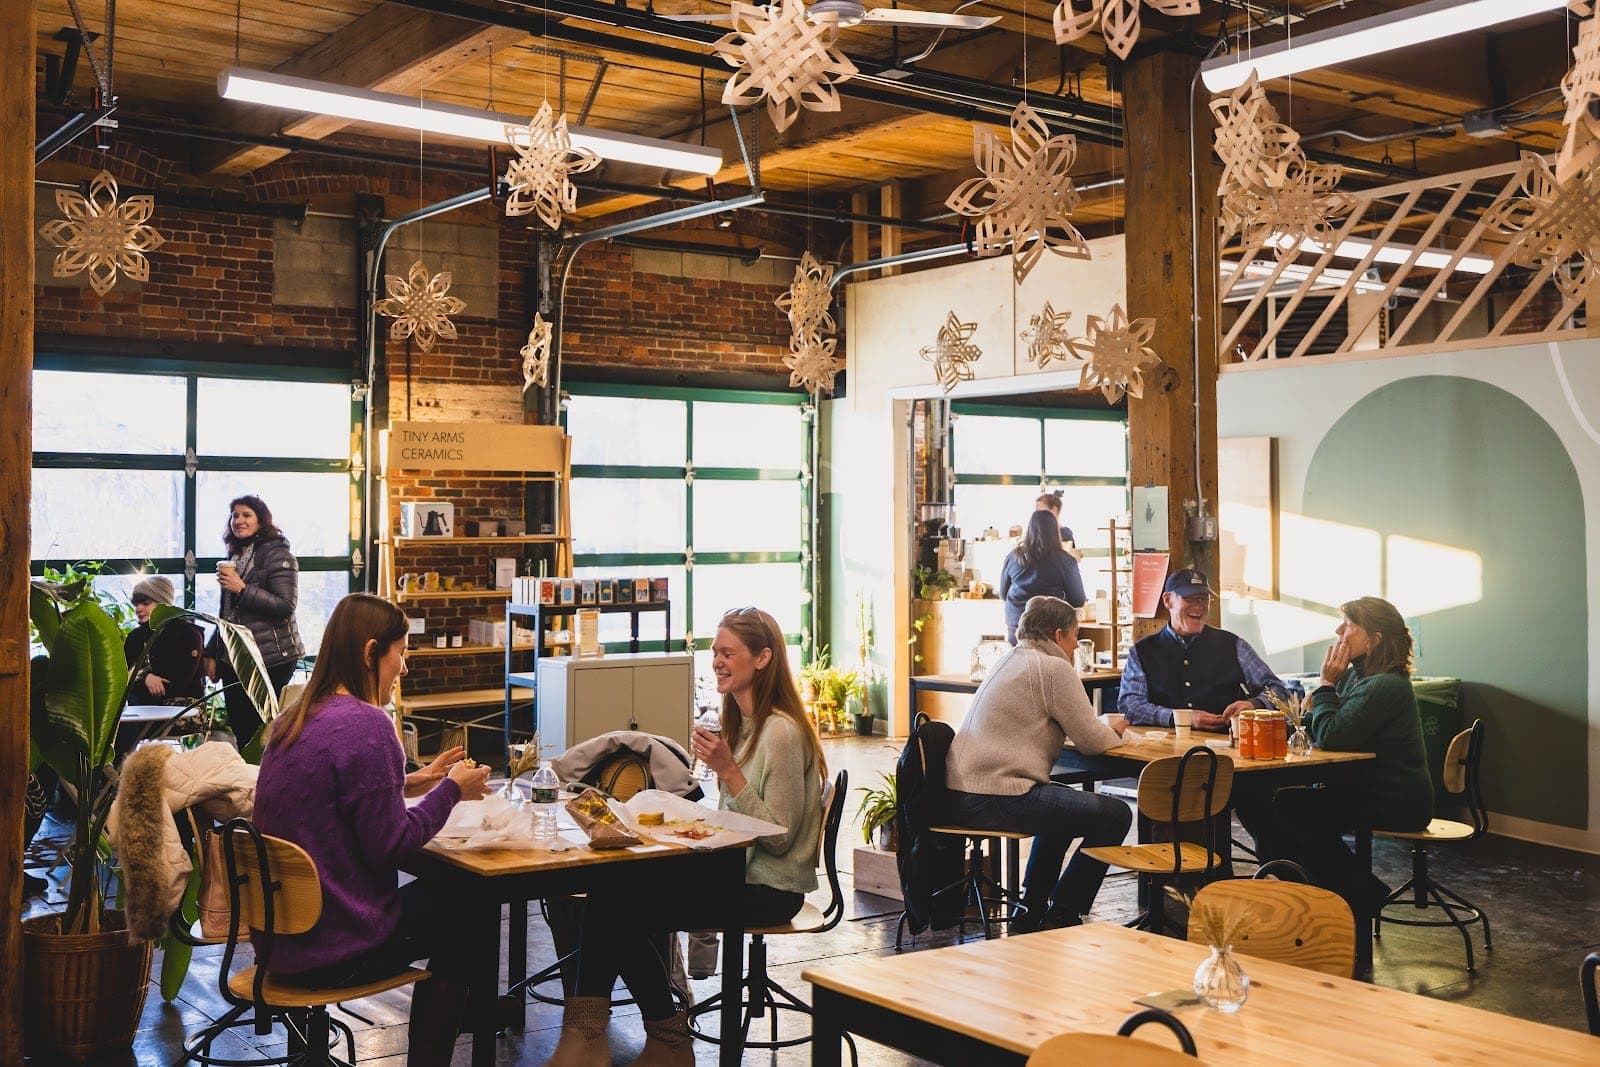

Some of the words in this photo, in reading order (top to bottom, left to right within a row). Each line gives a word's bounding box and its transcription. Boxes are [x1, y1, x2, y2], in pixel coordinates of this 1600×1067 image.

[401, 430, 430, 442] TINY
[431, 431, 465, 444] ARMS
[401, 447, 463, 461] CERAMICS
